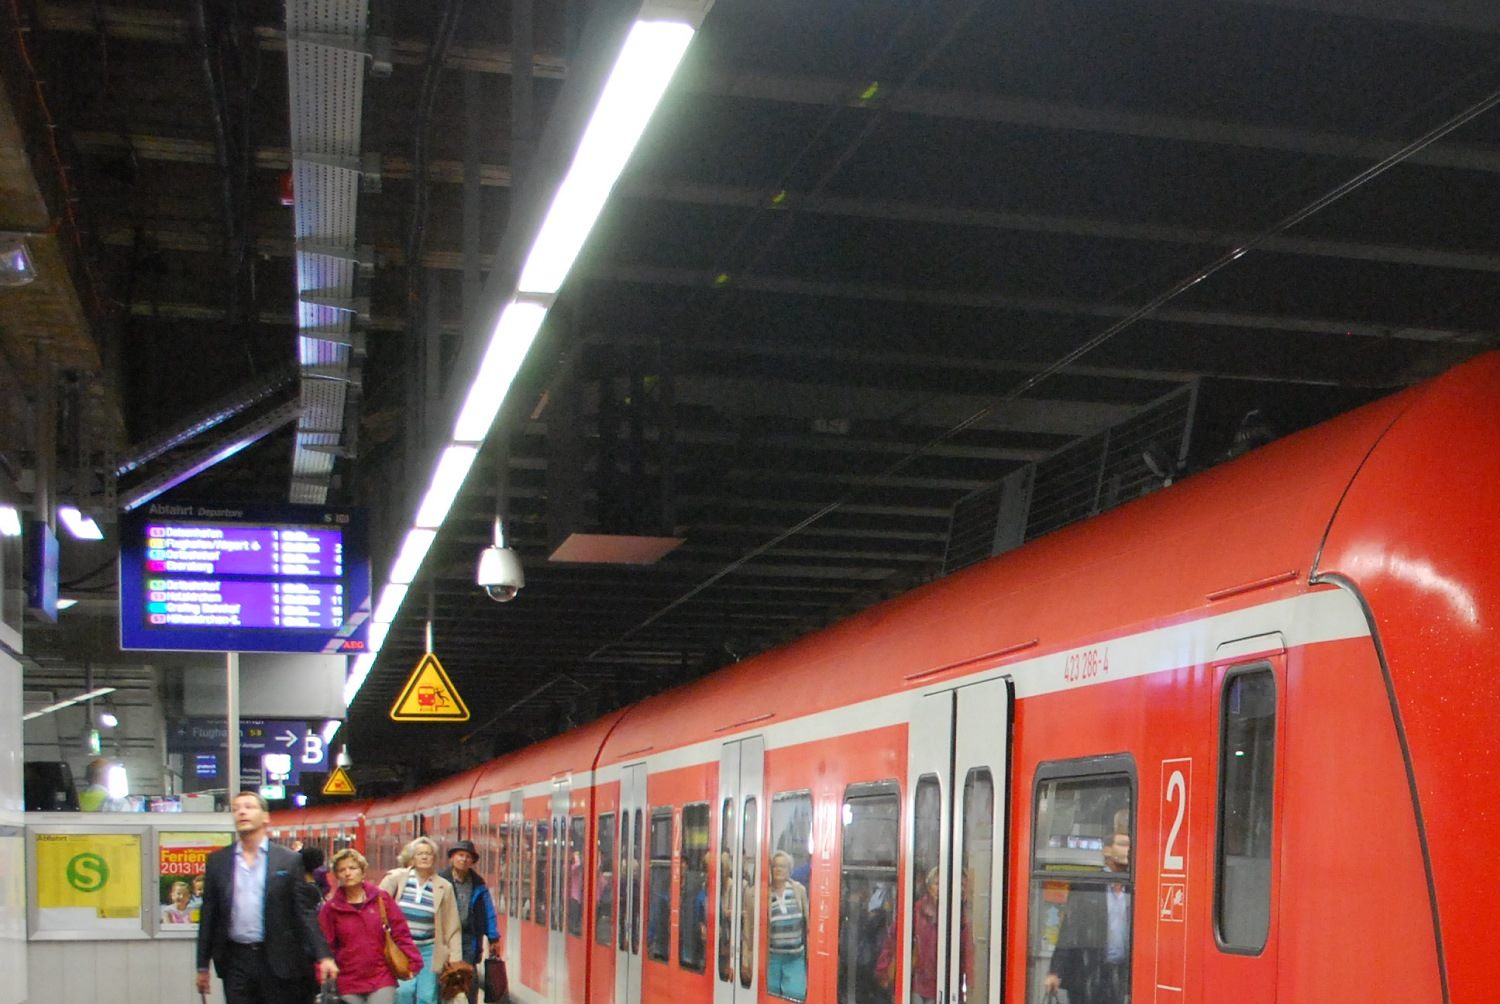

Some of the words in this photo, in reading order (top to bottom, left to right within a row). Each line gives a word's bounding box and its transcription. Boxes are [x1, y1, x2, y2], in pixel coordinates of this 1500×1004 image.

[149, 503, 193, 515] Abfahrt
[343, 641, 364, 649] AEG
[1064, 655, 1080, 681] 423
[1082, 647, 1109, 678] 286-4
[192, 727, 243, 738] Flughan
[301, 736, 324, 764] B
[1164, 771, 1186, 869] 2
[160, 850, 206, 862] Ferien
[72, 855, 103, 890] S
